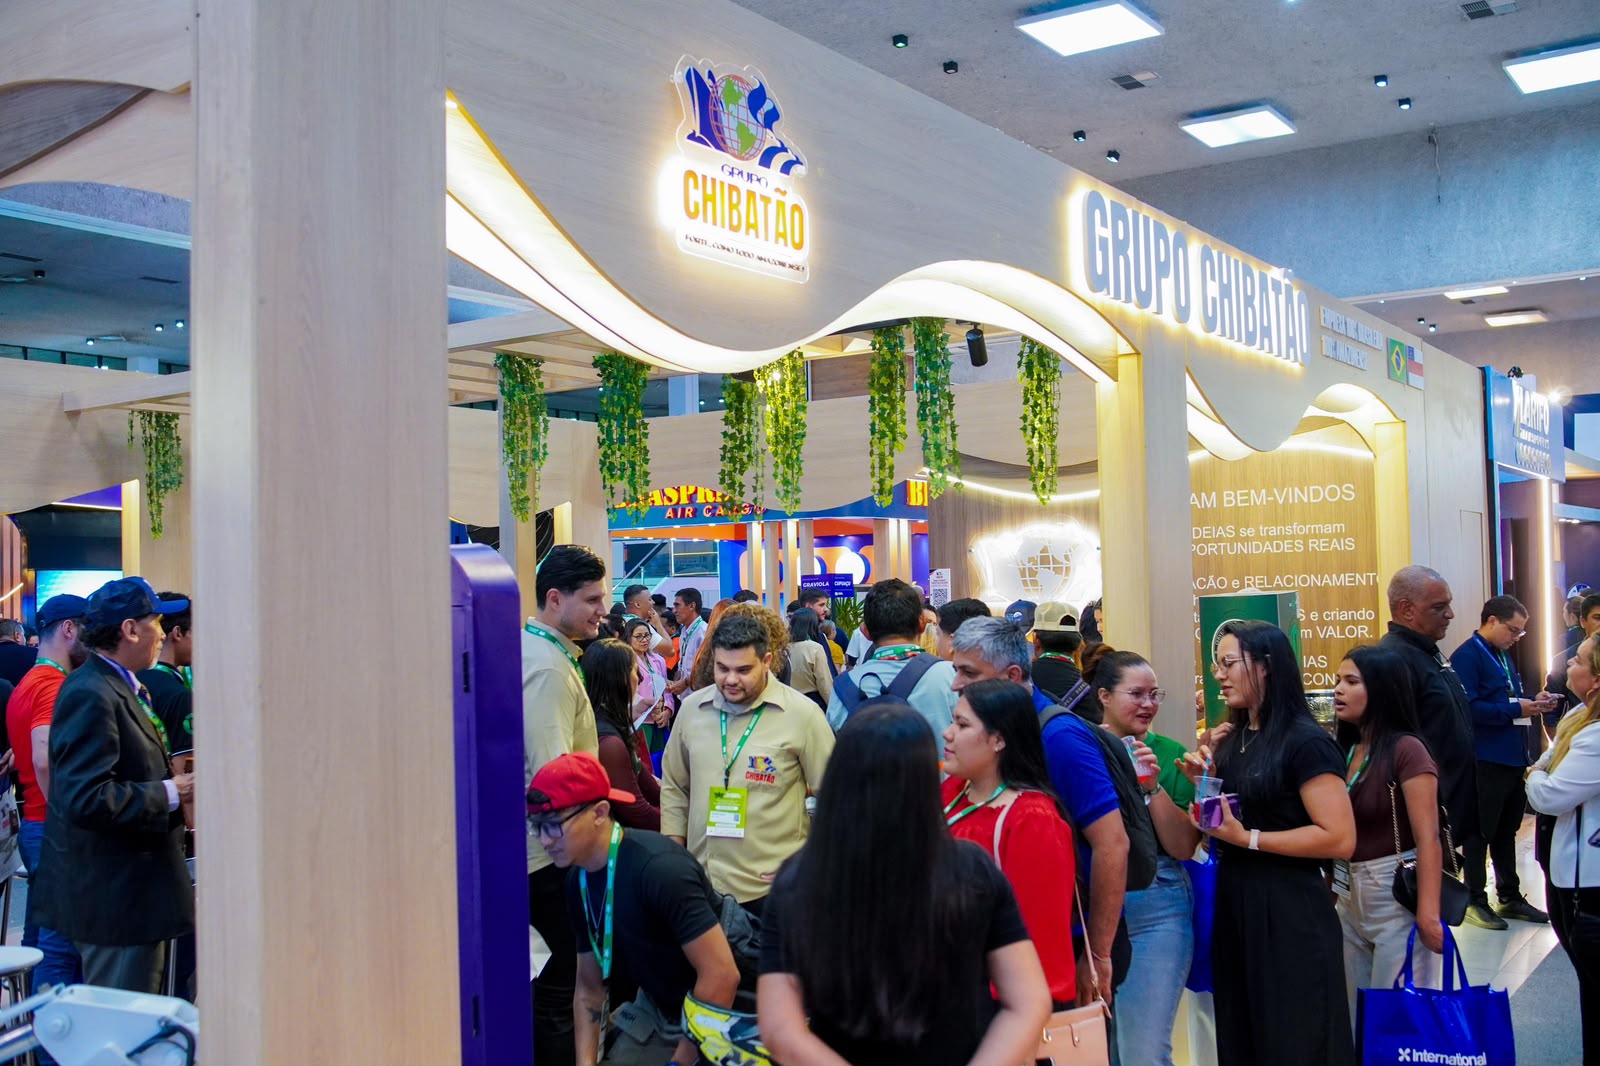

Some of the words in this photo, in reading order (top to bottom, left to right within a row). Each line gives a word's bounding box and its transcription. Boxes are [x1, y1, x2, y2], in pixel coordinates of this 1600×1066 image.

[721, 164, 769, 188] GRUPO
[683, 169, 805, 251] CHIBATÃO
[1083, 190, 1191, 324] GRUPO
[1200, 243, 1311, 368] CHIBATÃO
[1223, 484, 1356, 507] BEM-VINDOS
[664, 506, 695, 519] AIR
[703, 503, 766, 518] CAG
[1239, 528, 1256, 538] se
[1259, 522, 1345, 537] transformam
[1309, 537, 1356, 552] REAIS
[1231, 579, 1240, 589] e
[1244, 573, 1379, 589] RELACIONAMENT
[1310, 611, 1319, 621] e
[1323, 607, 1375, 621] criando
[1316, 625, 1373, 639] VALOR.
[1412, 1048, 1487, 1066] International
